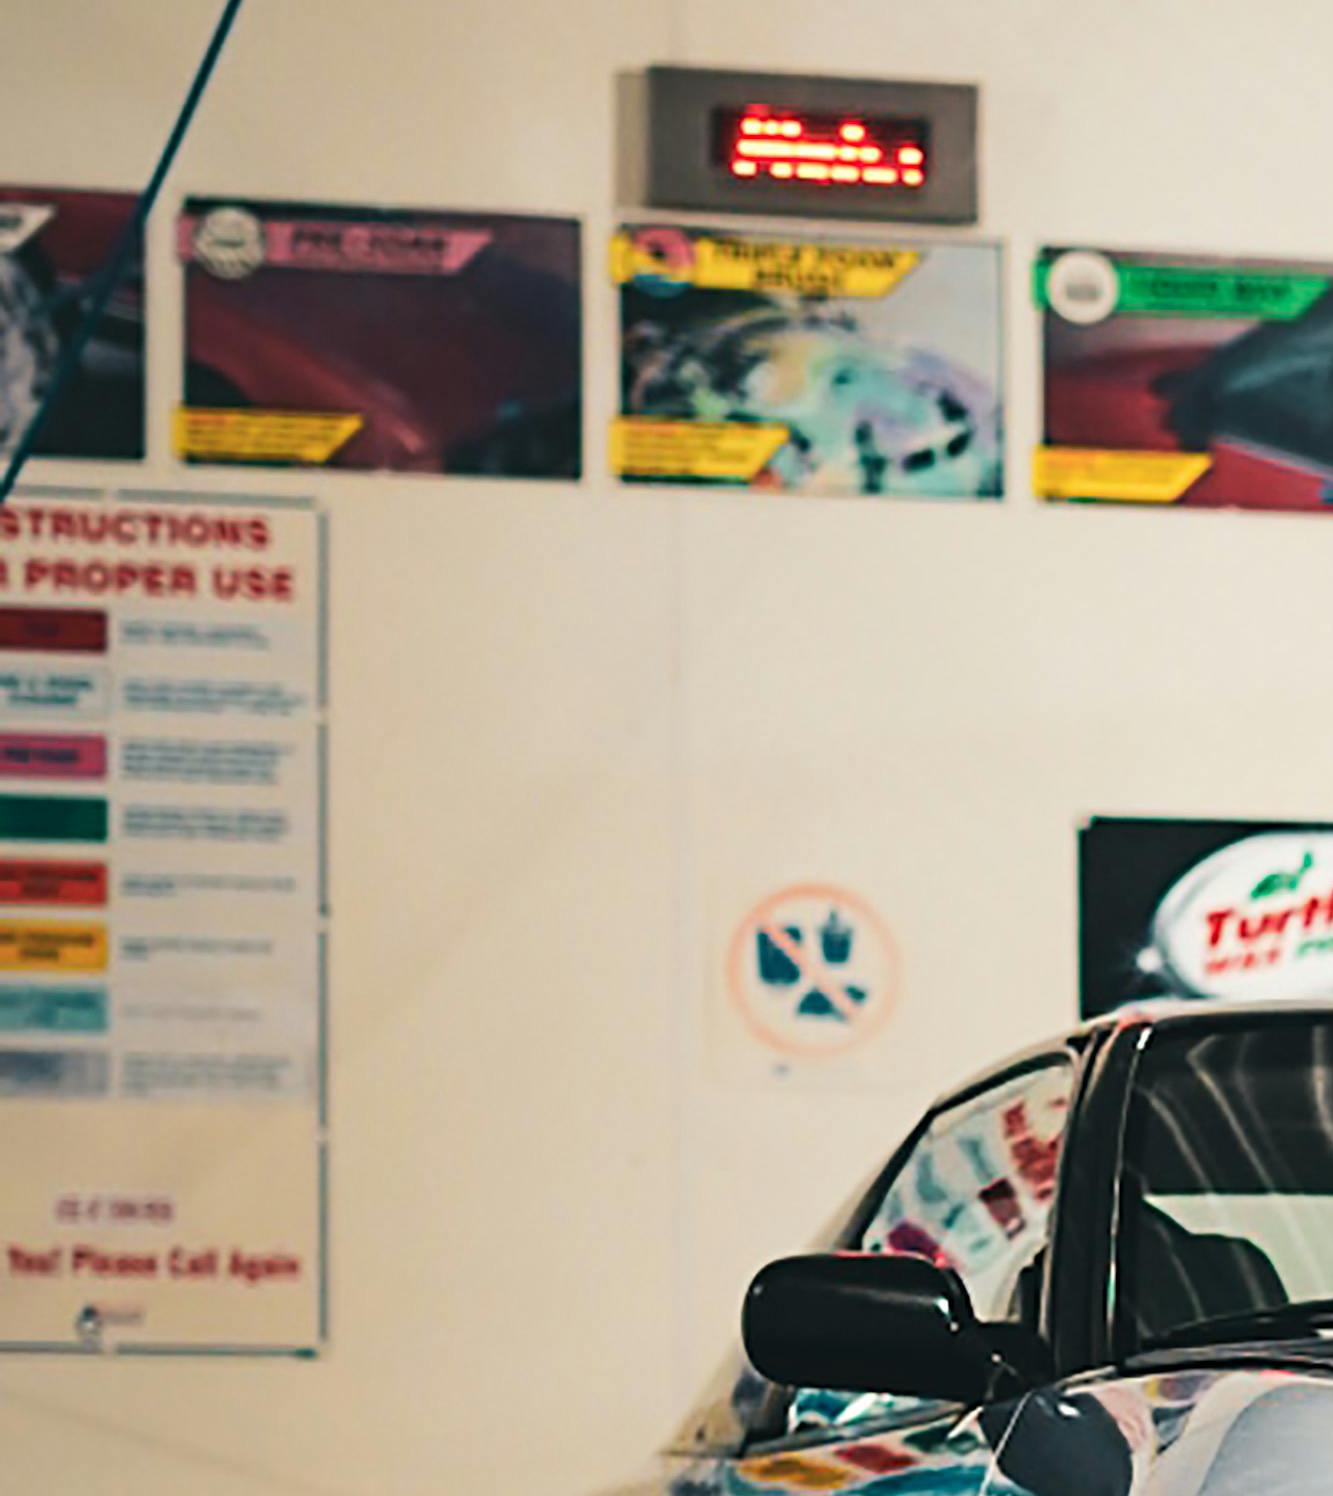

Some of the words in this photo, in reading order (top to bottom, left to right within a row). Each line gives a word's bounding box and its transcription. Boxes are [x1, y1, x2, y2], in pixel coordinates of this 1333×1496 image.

[24, 558, 196, 598] PROPER
[212, 565, 295, 602] USE
[72, 1245, 156, 1278] Please
[169, 1246, 217, 1278] Call
[229, 1247, 300, 1284] Again
